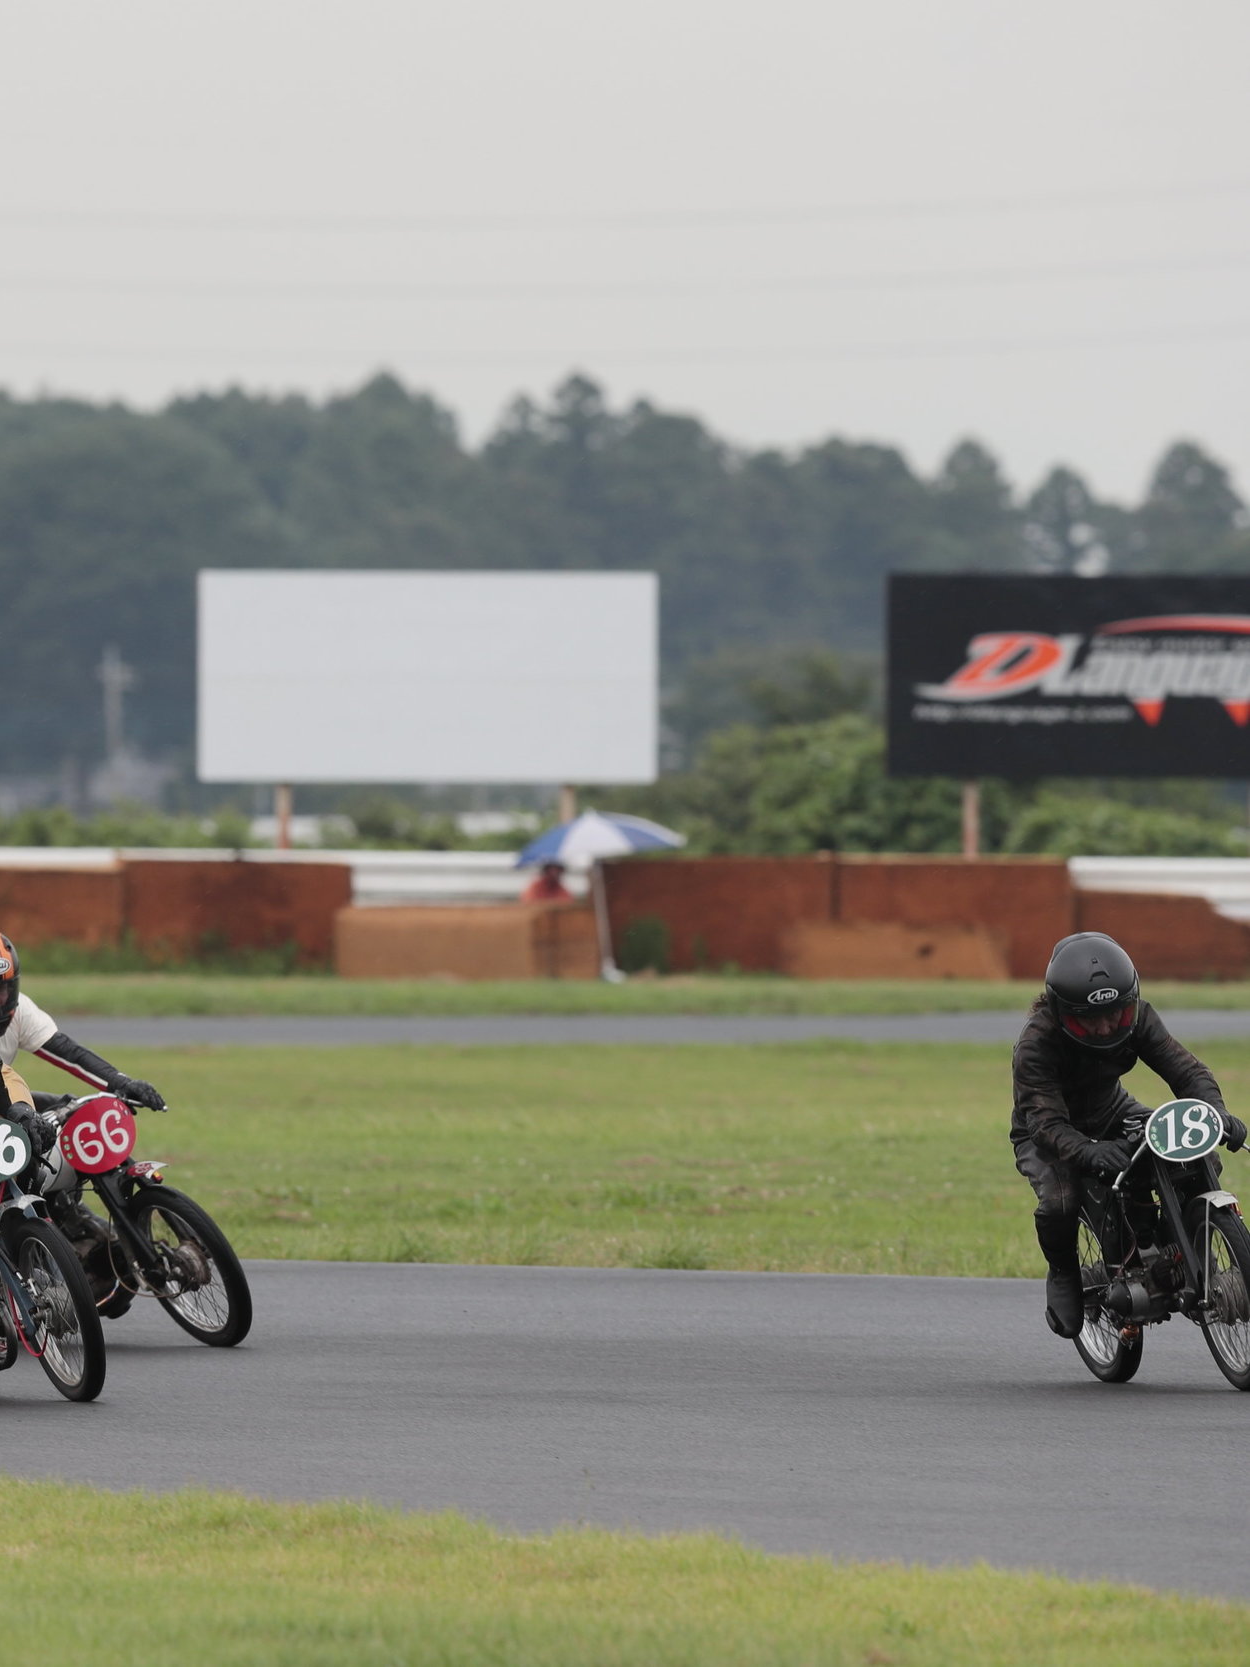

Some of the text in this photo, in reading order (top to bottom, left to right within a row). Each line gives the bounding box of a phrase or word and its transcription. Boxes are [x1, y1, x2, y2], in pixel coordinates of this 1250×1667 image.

[1088, 988, 1118, 1003] Arai
[72, 1109, 129, 1165] 66
[1158, 1104, 1210, 1155] 18
